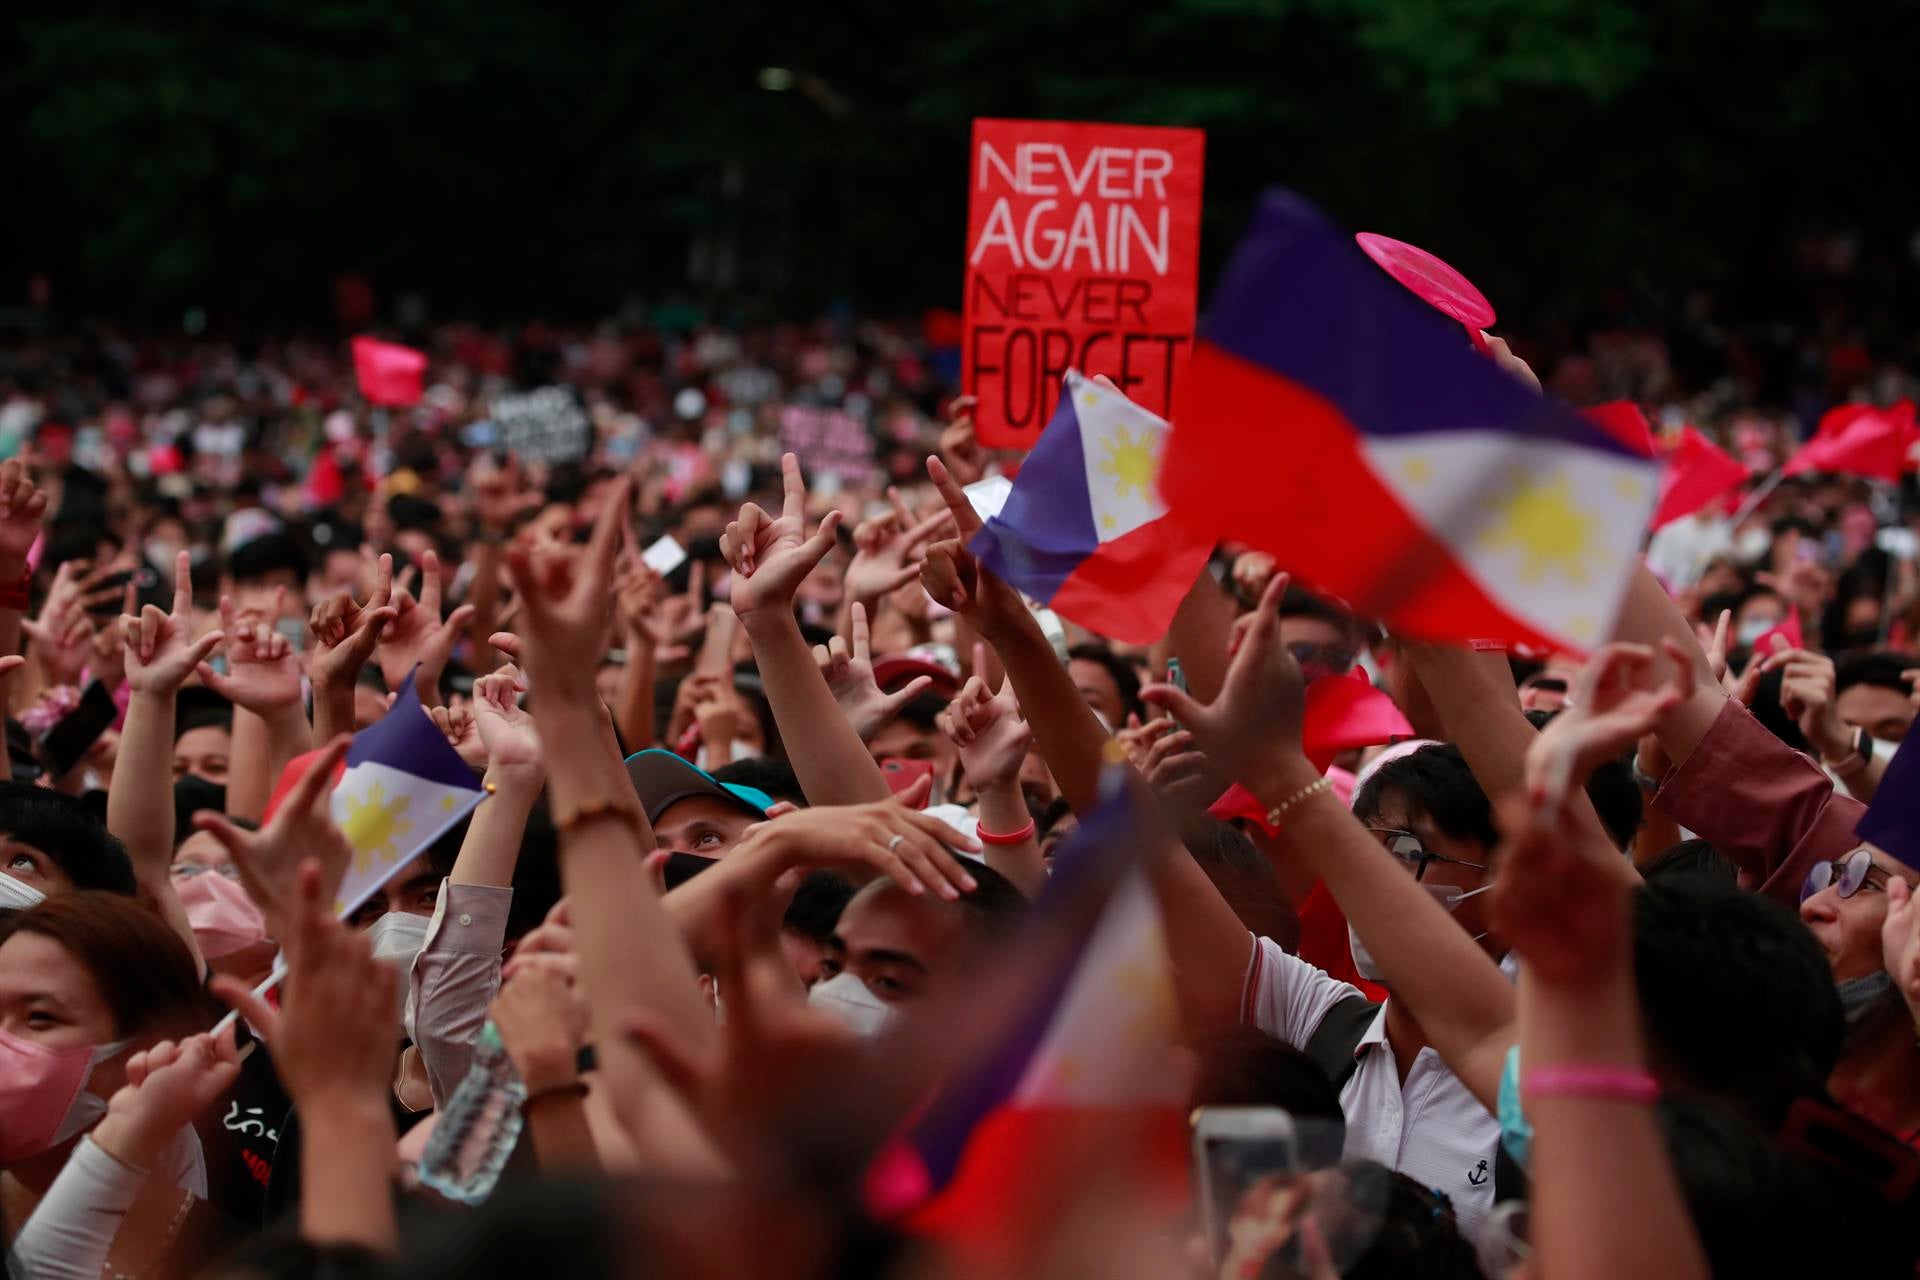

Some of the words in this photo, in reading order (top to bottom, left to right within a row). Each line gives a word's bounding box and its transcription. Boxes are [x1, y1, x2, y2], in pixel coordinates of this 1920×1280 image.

[978, 142, 1173, 199] NEVER
[971, 198, 1169, 275] AGAIN
[974, 274, 1153, 323] NEVER
